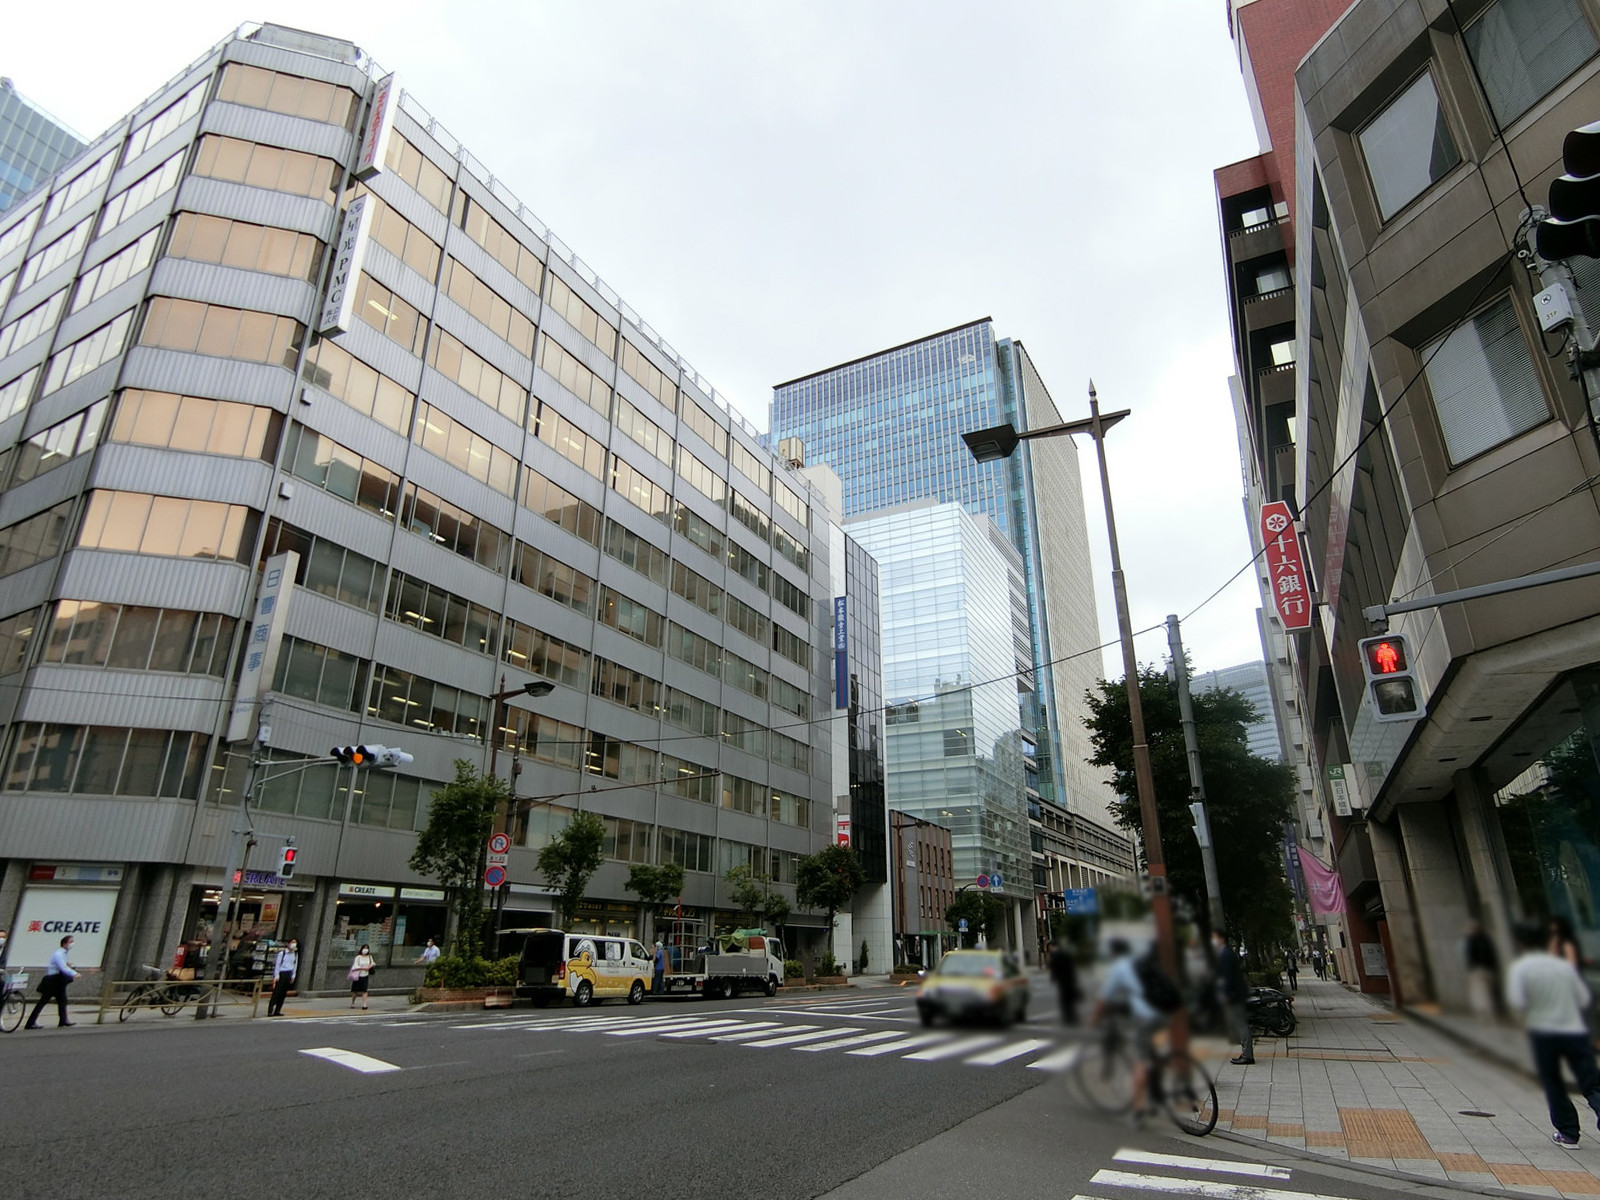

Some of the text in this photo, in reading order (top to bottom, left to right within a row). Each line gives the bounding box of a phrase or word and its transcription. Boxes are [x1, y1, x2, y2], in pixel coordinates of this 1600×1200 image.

[1271, 534, 1305, 616] 十六銀行
[248, 569, 281, 672] 日曹商事
[1329, 767, 1343, 775] JR
[1334, 781, 1348, 814] 新日本橋駅
[354, 886, 376, 894] CREATE
[43, 920, 101, 933] CREATE
